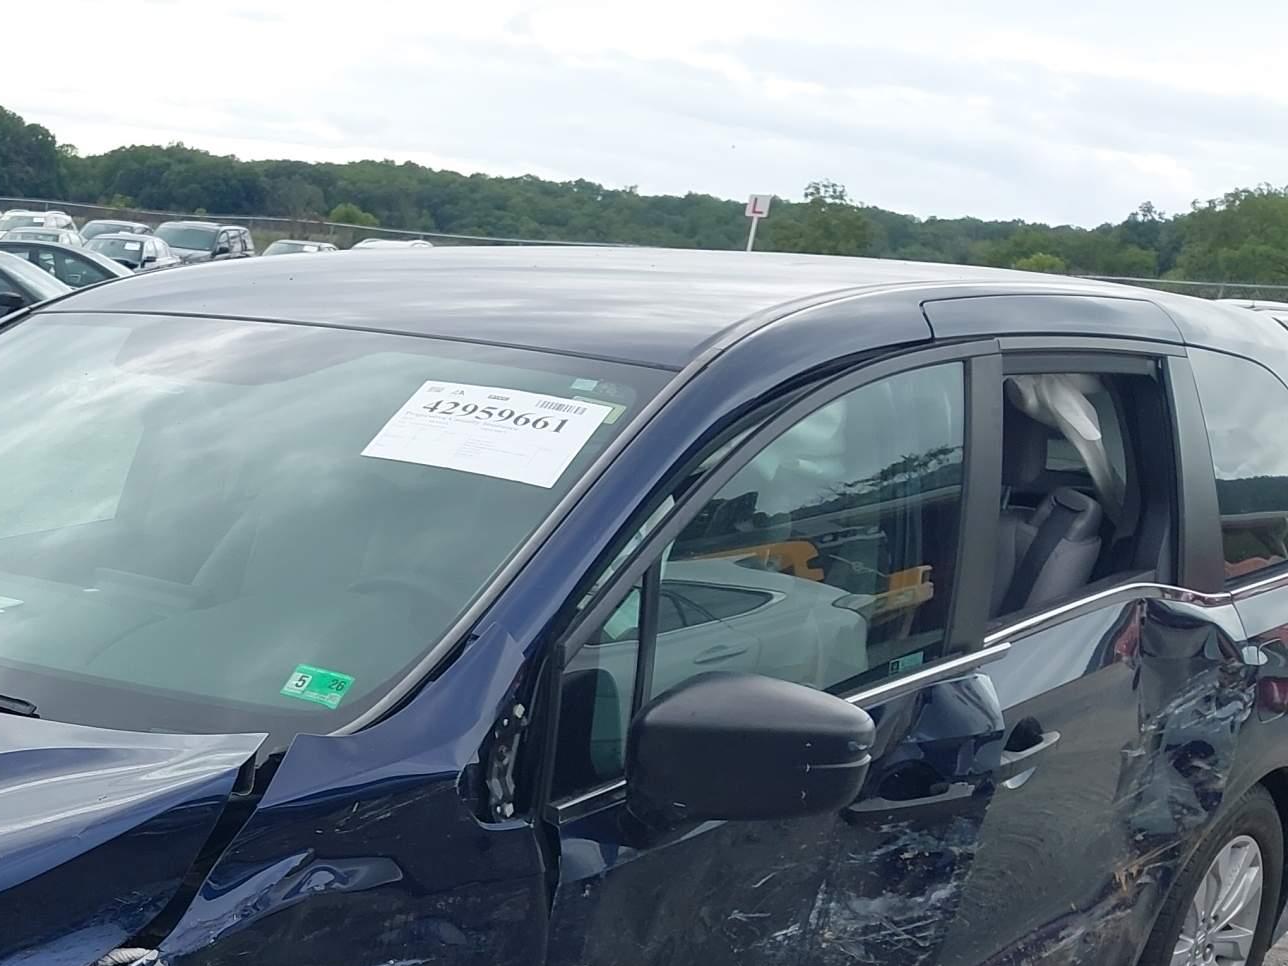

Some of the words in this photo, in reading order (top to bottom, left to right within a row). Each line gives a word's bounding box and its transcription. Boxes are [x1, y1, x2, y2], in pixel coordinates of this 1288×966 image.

[751, 197, 764, 215] L
[421, 399, 569, 434] 42959661
[295, 674, 309, 689] 5
[328, 678, 347, 692] 26
